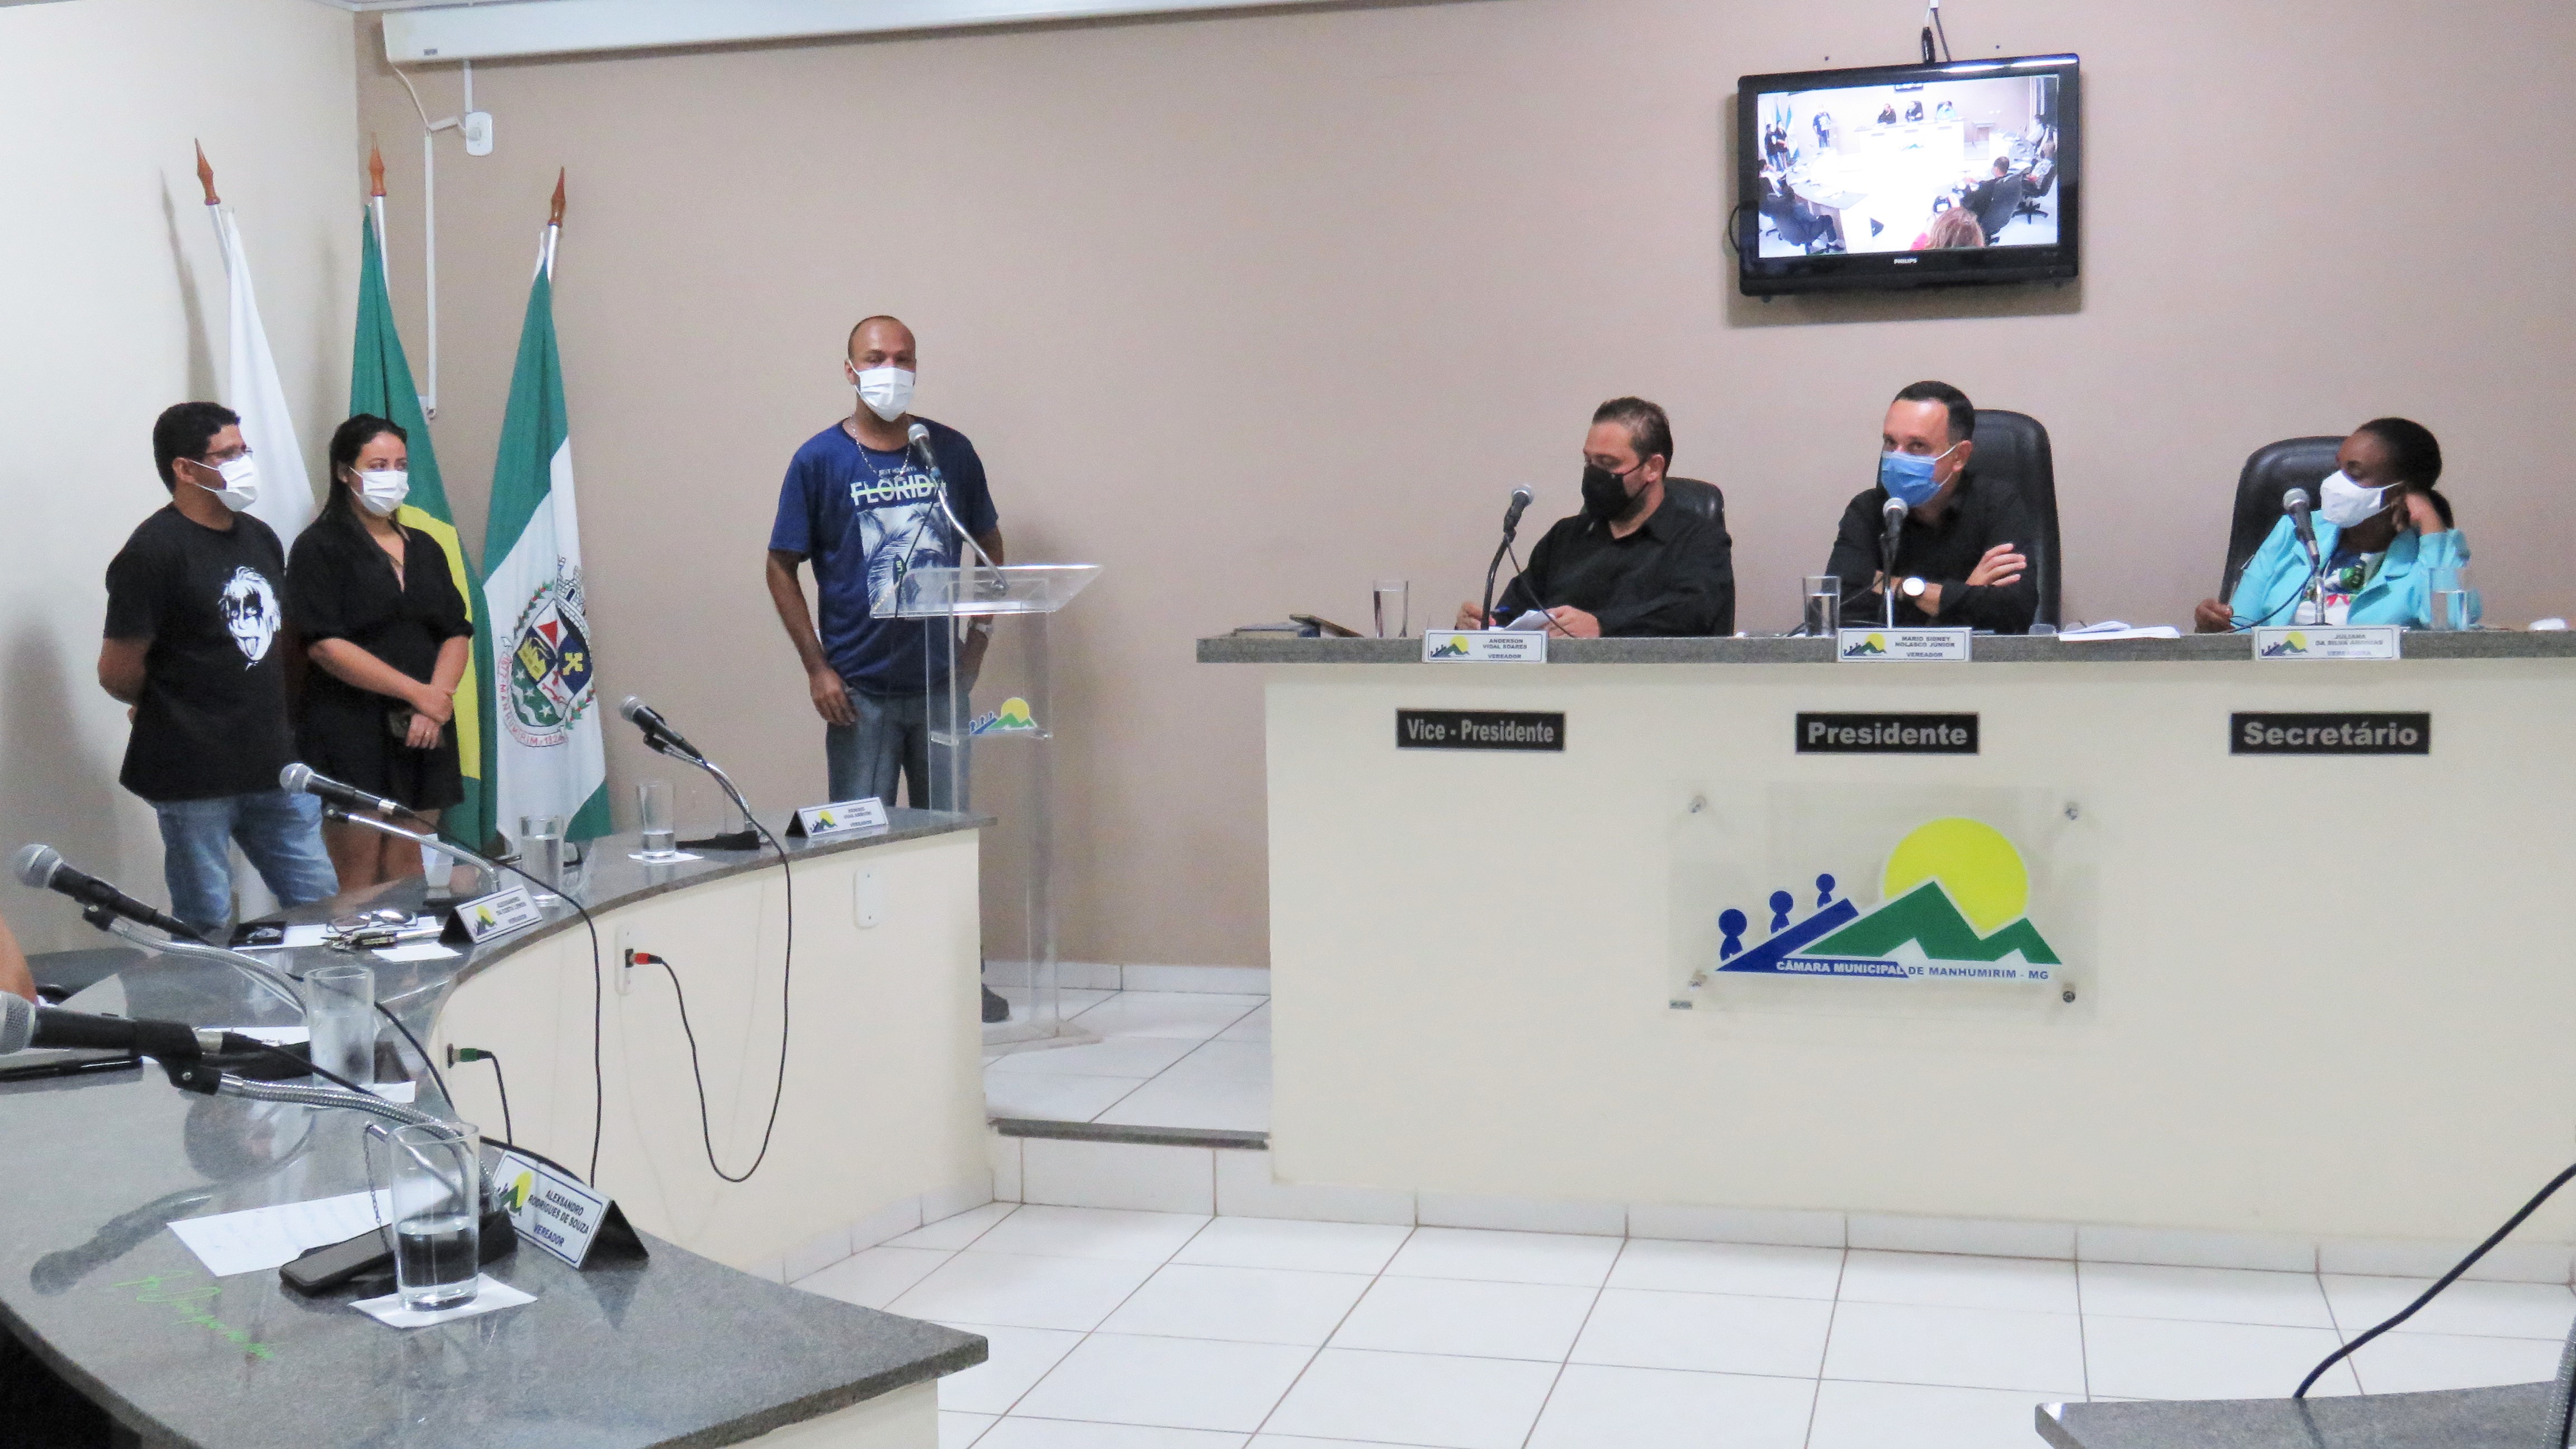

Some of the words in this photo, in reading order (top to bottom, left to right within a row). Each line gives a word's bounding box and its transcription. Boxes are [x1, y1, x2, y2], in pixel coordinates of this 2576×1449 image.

[1407, 718, 1446, 740] Vice
[1461, 719, 1555, 742] Presidente
[1808, 722, 1968, 745] Presidente
[2243, 720, 2419, 745] Secretário
[1776, 960, 1830, 972] CÂMARA
[1834, 963, 1905, 975] MUNICIPAL
[1908, 967, 1924, 975] DE
[1929, 967, 2016, 978] MANHUMIRIM
[2028, 970, 2049, 979] MG
[528, 1194, 560, 1219] RODRIGUES
[560, 1212, 570, 1224] DE
[569, 1216, 589, 1234] SOUZA
[533, 1223, 565, 1247] VEREADOR
